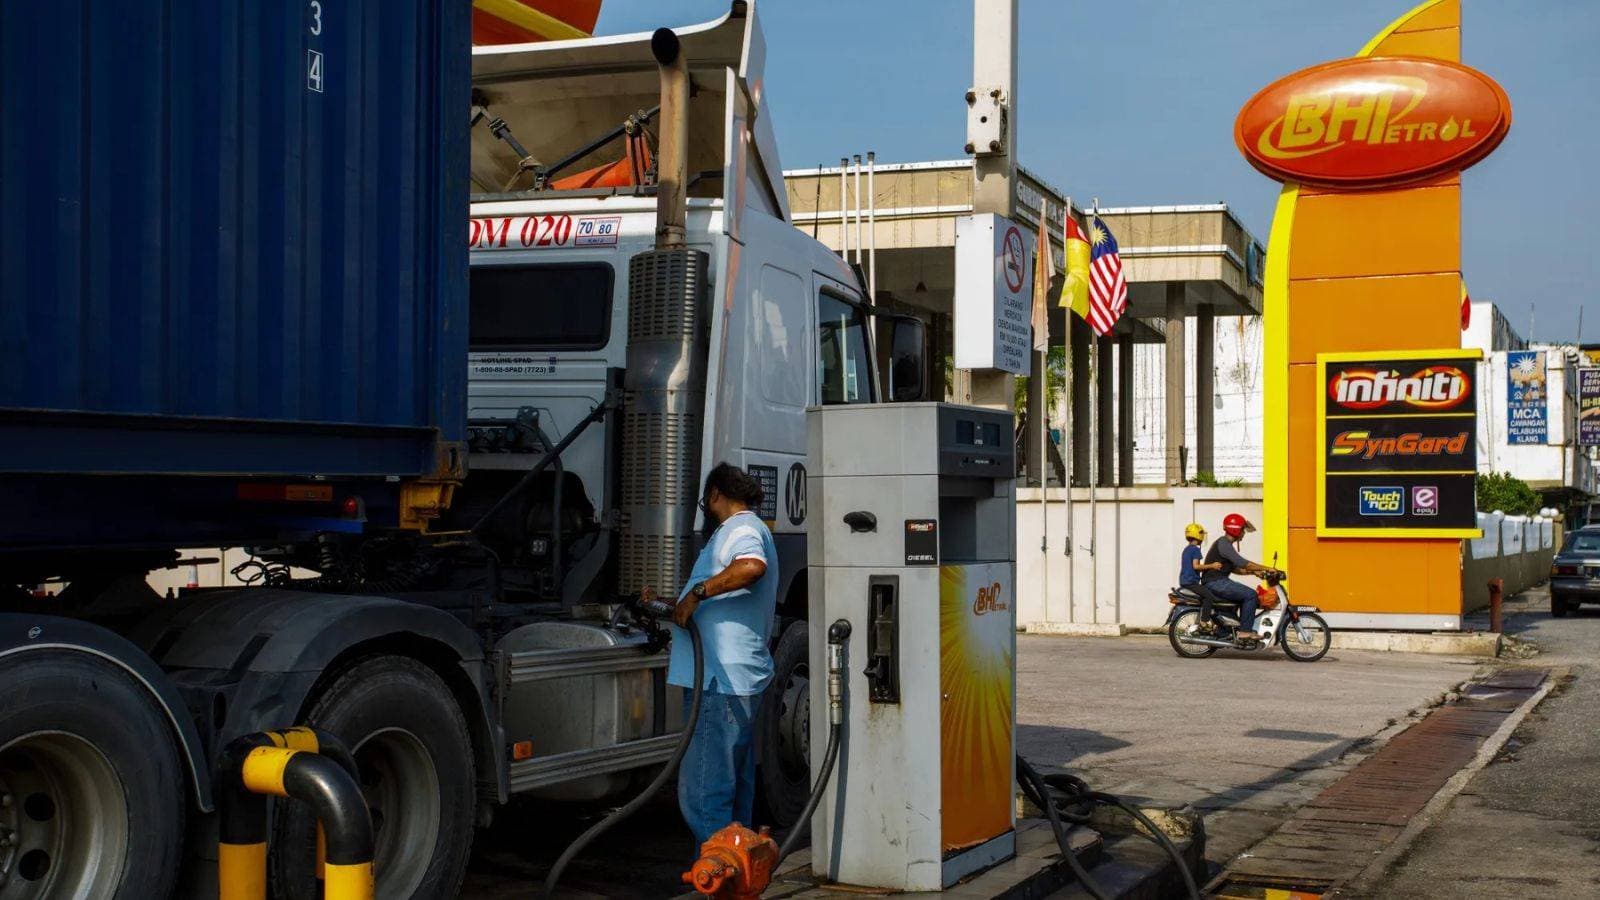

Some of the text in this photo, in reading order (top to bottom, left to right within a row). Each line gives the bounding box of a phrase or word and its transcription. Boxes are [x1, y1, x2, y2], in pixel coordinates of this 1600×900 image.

[310, 1, 322, 35] 3
[310, 54, 321, 90] 4
[520, 213, 572, 248] 020
[579, 221, 593, 234] 70
[598, 224, 612, 234] 80
[1336, 369, 1462, 403] infiniti
[1513, 409, 1540, 419] MCA
[1510, 420, 1545, 428] CAWANGAN
[1509, 427, 1546, 435] PELABUHAN
[1330, 431, 1469, 460] SynGard
[1516, 435, 1539, 443] KLANG
[788, 469, 807, 519] KA
[1362, 490, 1401, 501] Touch
